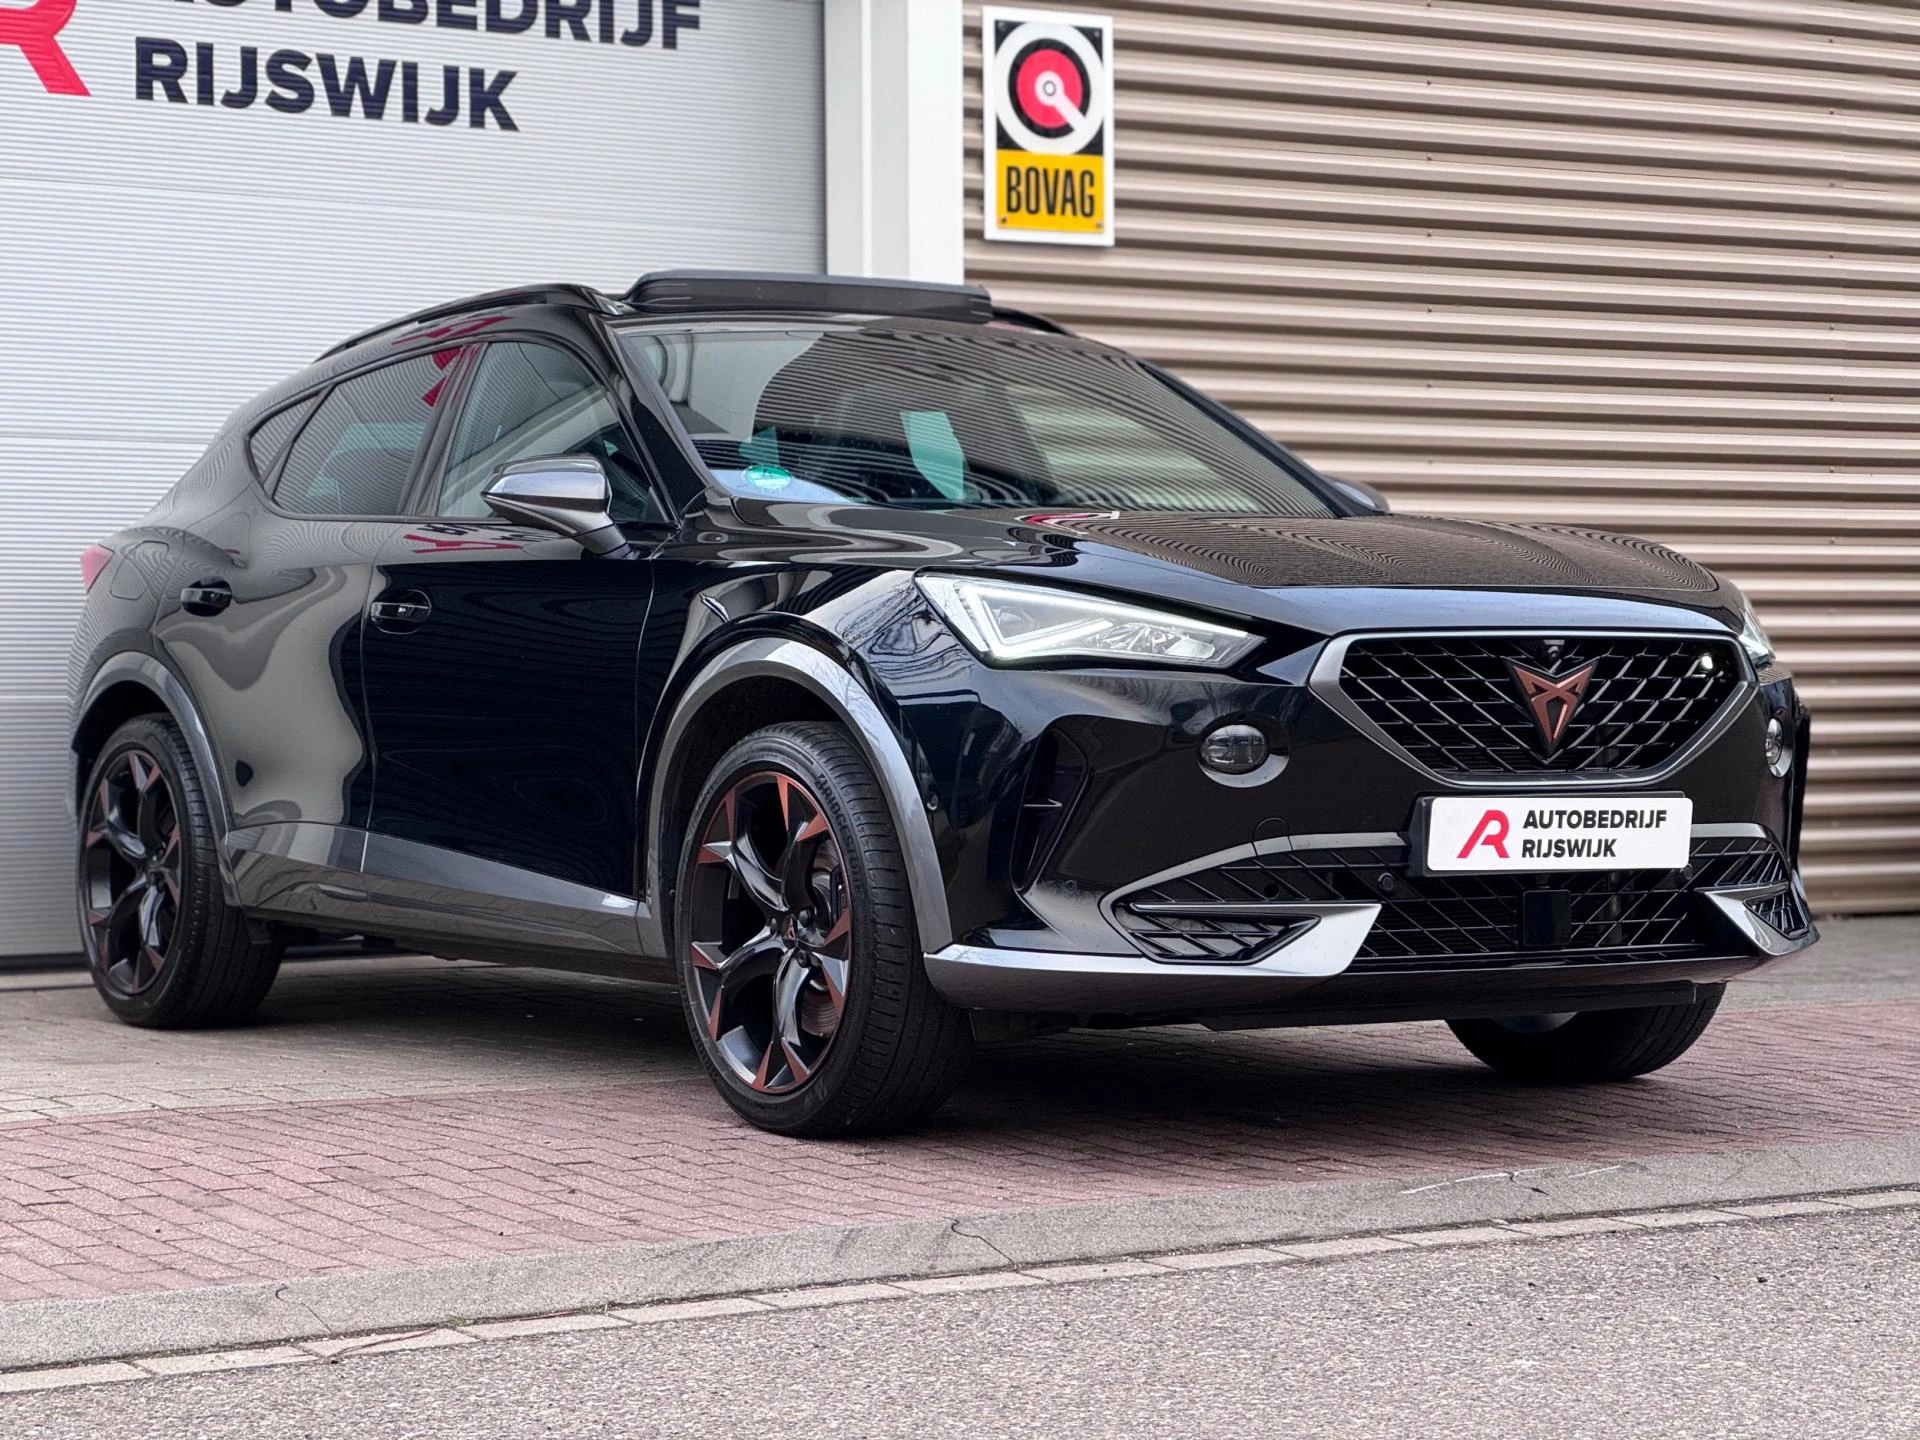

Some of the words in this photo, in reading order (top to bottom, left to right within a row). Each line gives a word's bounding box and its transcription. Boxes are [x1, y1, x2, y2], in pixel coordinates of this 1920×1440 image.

[135, 36, 520, 132] RIJSWIJK
[1006, 165, 1095, 218] BOVAG
[1522, 809, 1668, 829] AUTOBEDRIJF
[1521, 838, 1617, 858] RIJSWIJK
